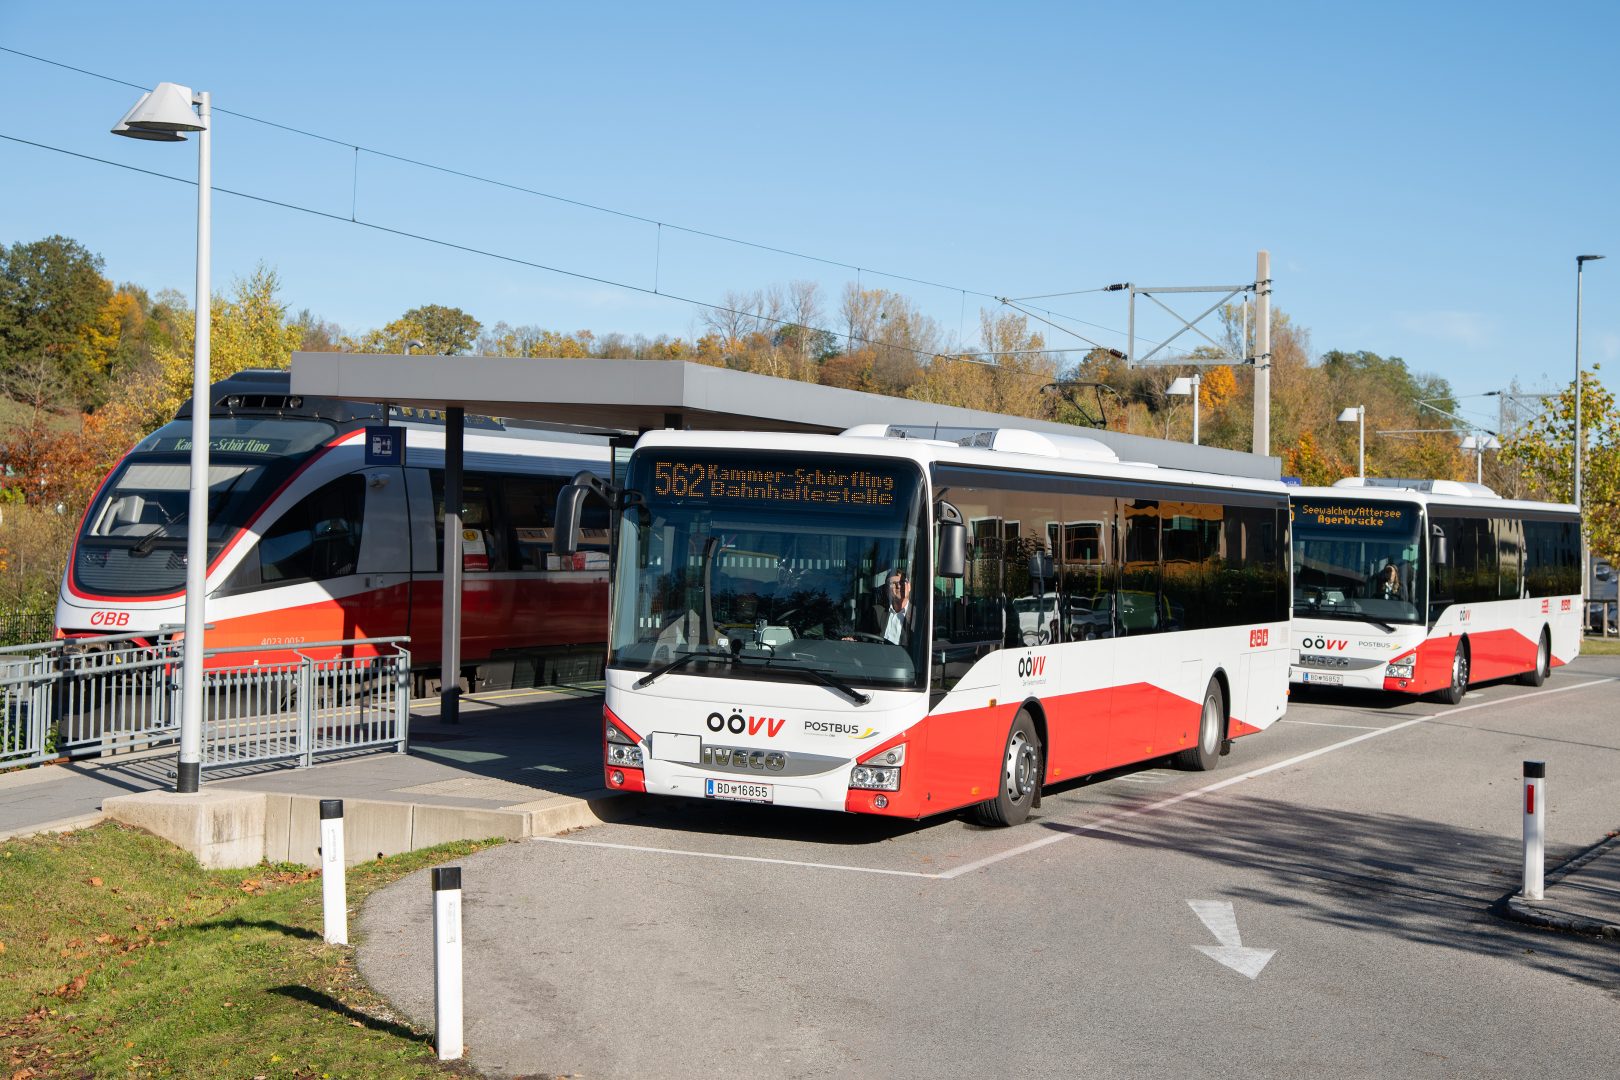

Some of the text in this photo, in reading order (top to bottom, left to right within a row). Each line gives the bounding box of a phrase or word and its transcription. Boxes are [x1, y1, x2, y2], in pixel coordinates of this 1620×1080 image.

[174, 439, 270, 452] Kamr-Schörfling
[655, 462, 894, 497] 562 Kammer-Schörfling
[710, 481, 893, 505] Bahnhaltestelle
[1302, 504, 1402, 518] Seewalchen/Attersee
[1317, 514, 1384, 526] Agerbrücke
[90, 611, 130, 626] ÖBB
[1302, 635, 1348, 650] OÖVV
[1358, 640, 1391, 649] POSTBUS
[1018, 650, 1046, 678] OÖVV
[706, 707, 786, 738] OÖVV
[804, 721, 859, 734] POSTBUS
[703, 747, 786, 771] IVECO
[717, 783, 730, 794] BD
[737, 785, 768, 798] 16855
